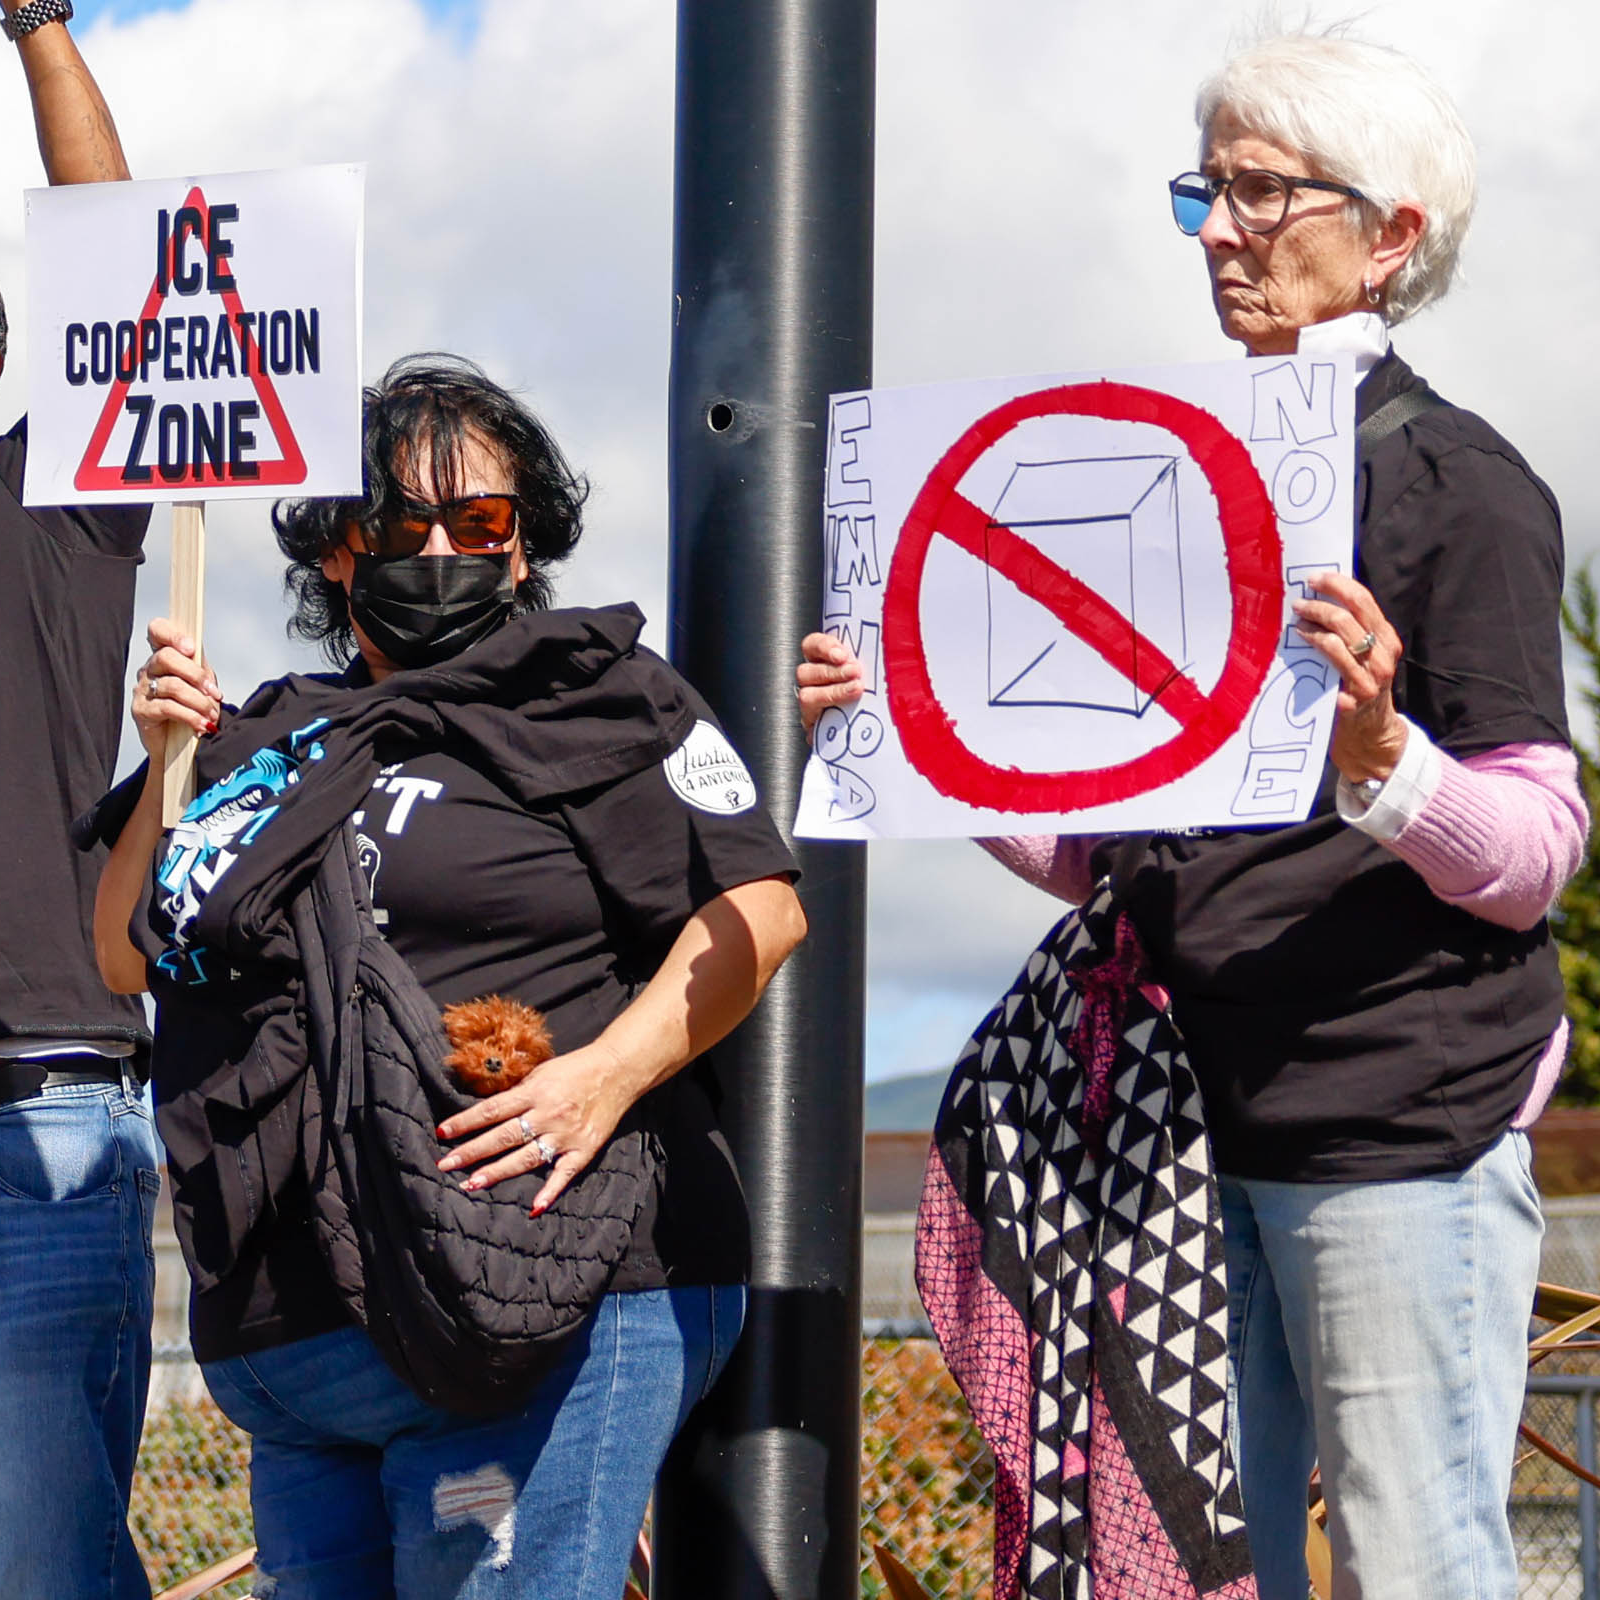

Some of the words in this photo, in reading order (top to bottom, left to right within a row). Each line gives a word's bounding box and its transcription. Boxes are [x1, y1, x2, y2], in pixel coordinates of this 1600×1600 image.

[157, 204, 239, 297] ICE
[66, 308, 320, 386] COOPERATION
[121, 394, 260, 484] ZONE
